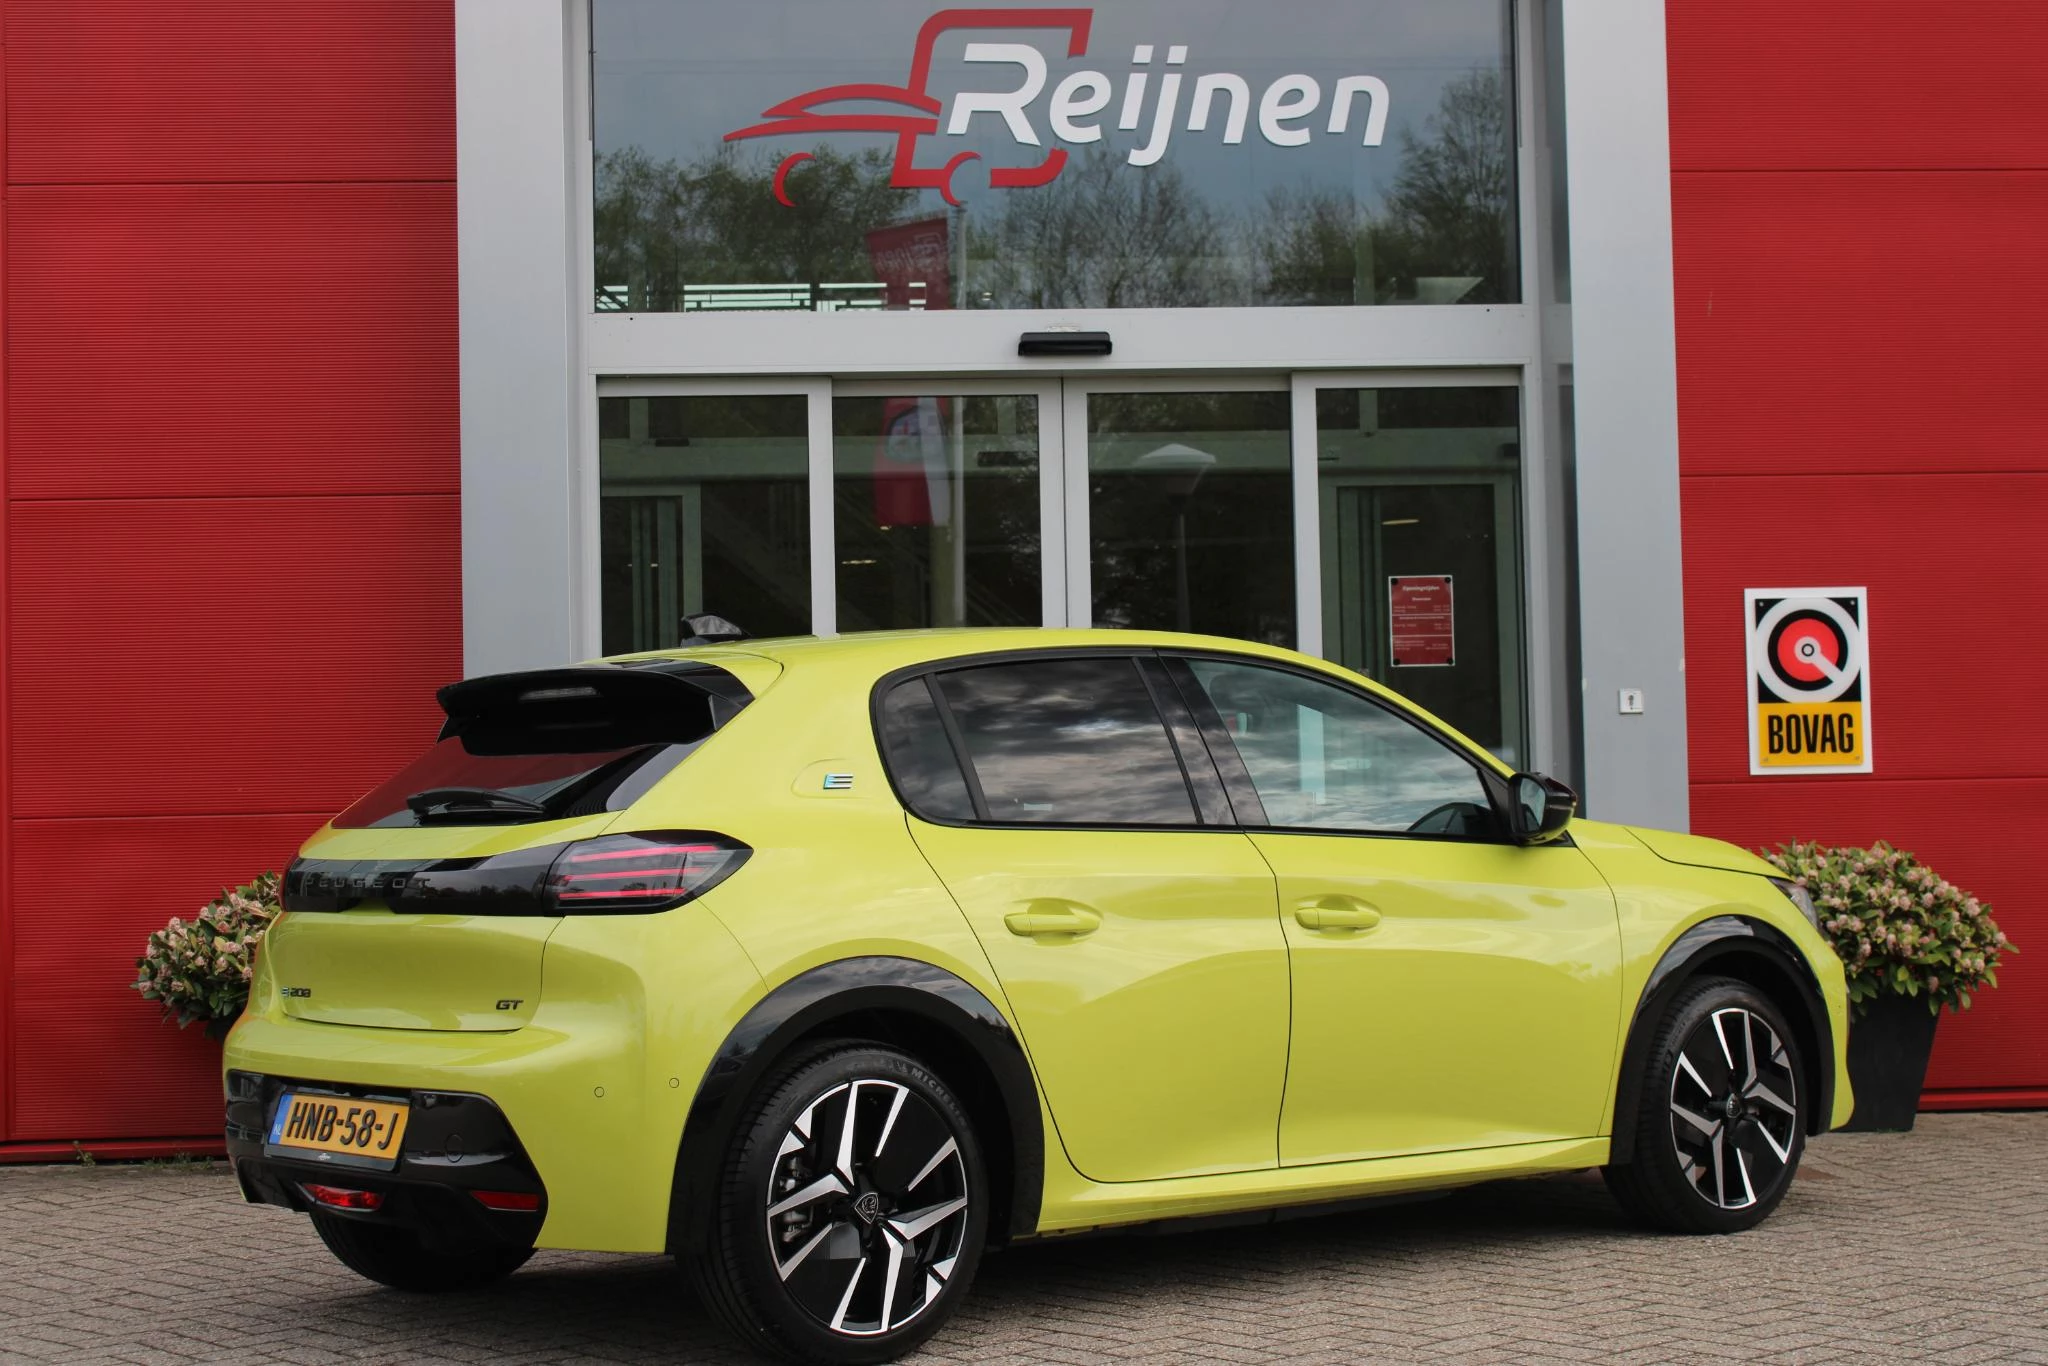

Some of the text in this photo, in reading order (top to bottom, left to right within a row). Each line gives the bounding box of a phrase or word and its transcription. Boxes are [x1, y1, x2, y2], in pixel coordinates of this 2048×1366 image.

[947, 43, 1389, 166] Reijnen
[1768, 713, 1854, 754] BOVAG
[495, 1000, 524, 1011] GT
[286, 1101, 399, 1150] HNB-58-J
